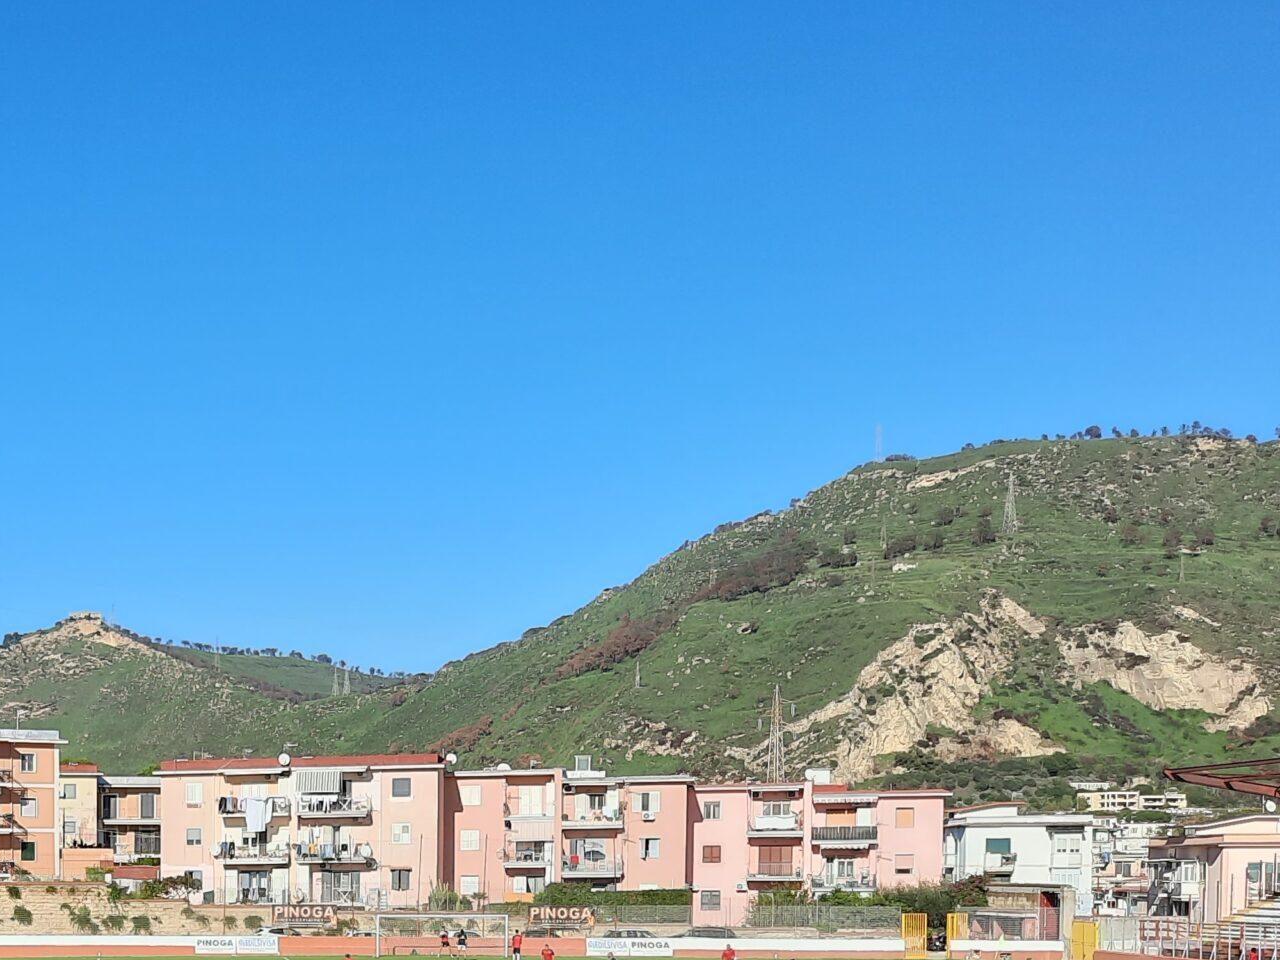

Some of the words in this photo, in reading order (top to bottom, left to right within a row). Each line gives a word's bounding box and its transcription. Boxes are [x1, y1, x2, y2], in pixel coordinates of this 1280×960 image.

[274, 905, 334, 918] PINOGA
[530, 907, 592, 919] PINOGA
[197, 939, 234, 947] PINOGA
[631, 941, 670, 949] PINOGA
